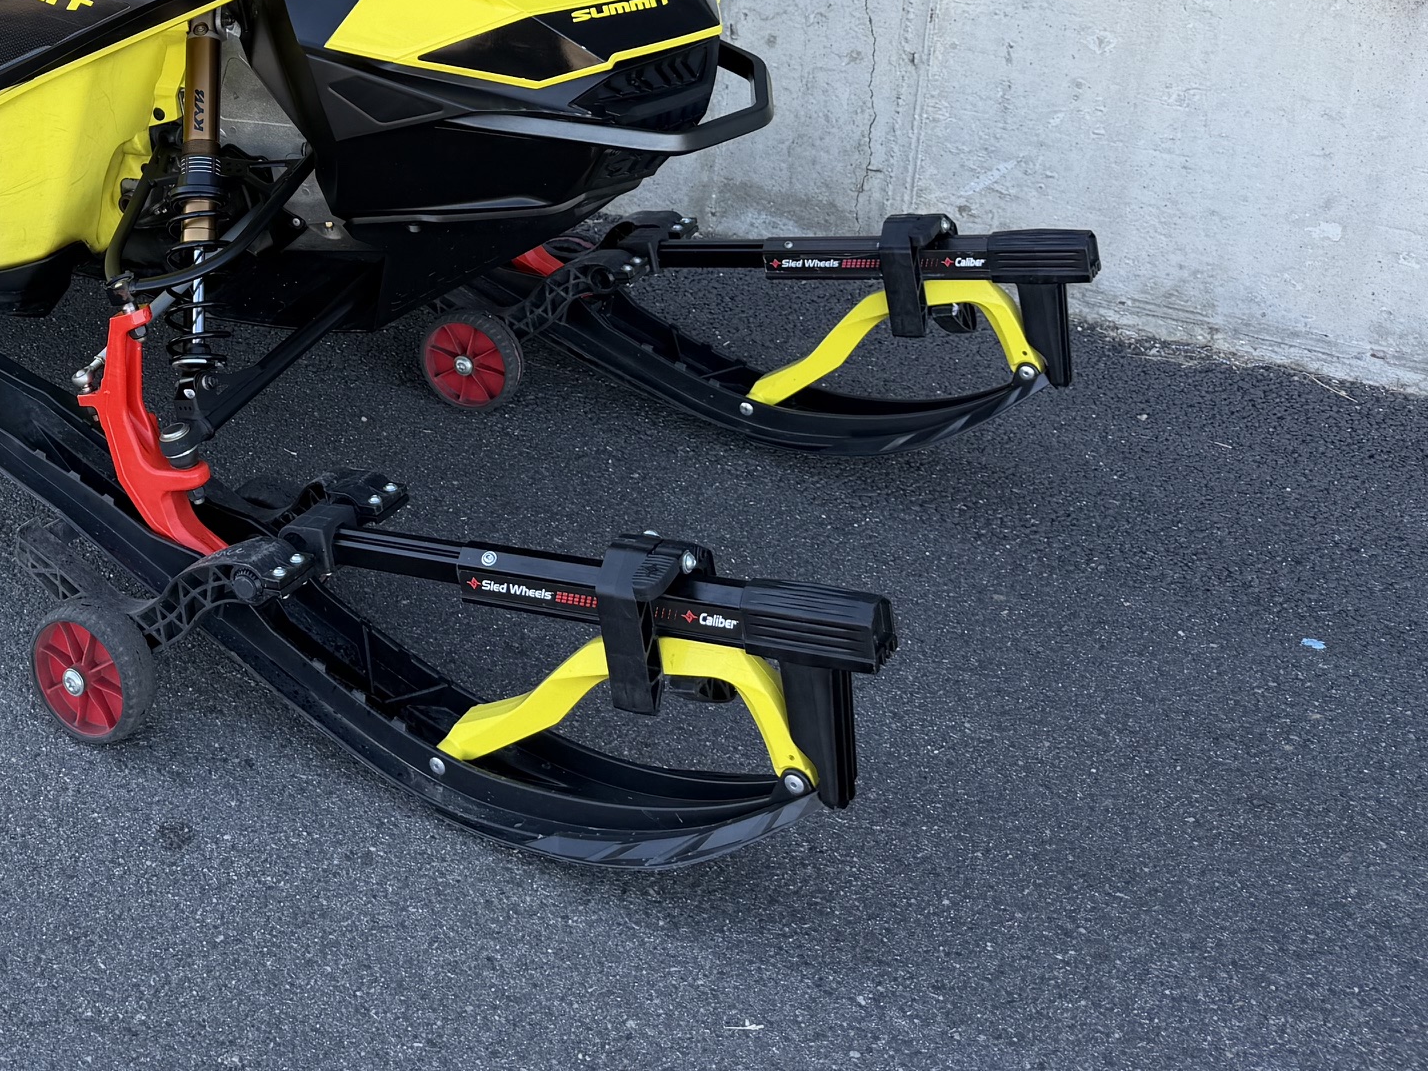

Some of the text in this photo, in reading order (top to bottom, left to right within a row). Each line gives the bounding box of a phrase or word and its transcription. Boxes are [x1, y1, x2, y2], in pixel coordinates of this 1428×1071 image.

[193, 89, 205, 132] KYB
[781, 258, 840, 268] Sled Wheels
[954, 257, 986, 267] Caliber
[481, 579, 553, 600] Sled Wheels
[699, 612, 738, 629] Caliber
